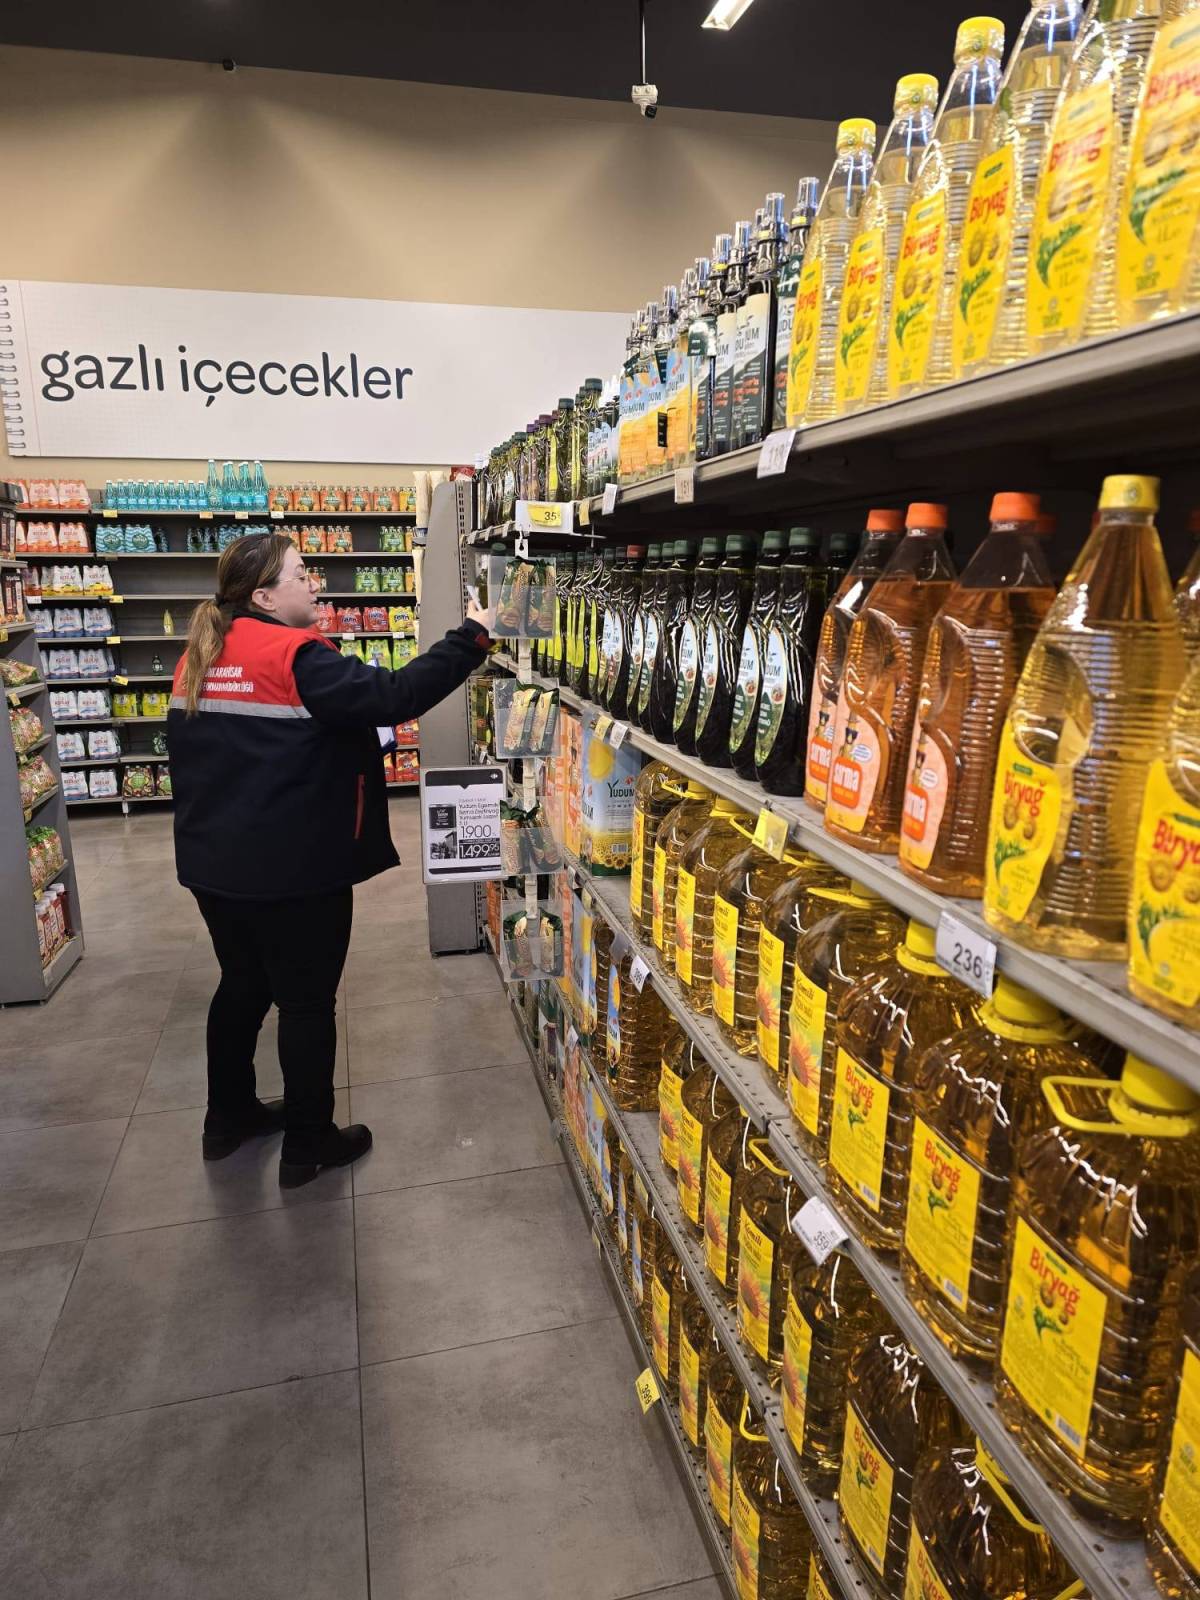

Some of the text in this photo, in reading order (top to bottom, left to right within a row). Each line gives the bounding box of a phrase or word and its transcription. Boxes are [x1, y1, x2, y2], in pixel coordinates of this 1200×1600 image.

[970, 182, 1008, 224] Biryağ
[40, 343, 413, 407] gazlı içecekler
[544, 511, 557, 521] 35
[1004, 772, 1047, 817] Biryağ
[461, 825, 491, 838] 1.900
[953, 942, 982, 978] 236
[845, 1065, 874, 1109] Biryağ
[924, 1139, 962, 1193] Biryağ
[1030, 1247, 1080, 1317] Biryağ
[854, 1424, 880, 1482] Biryağ
